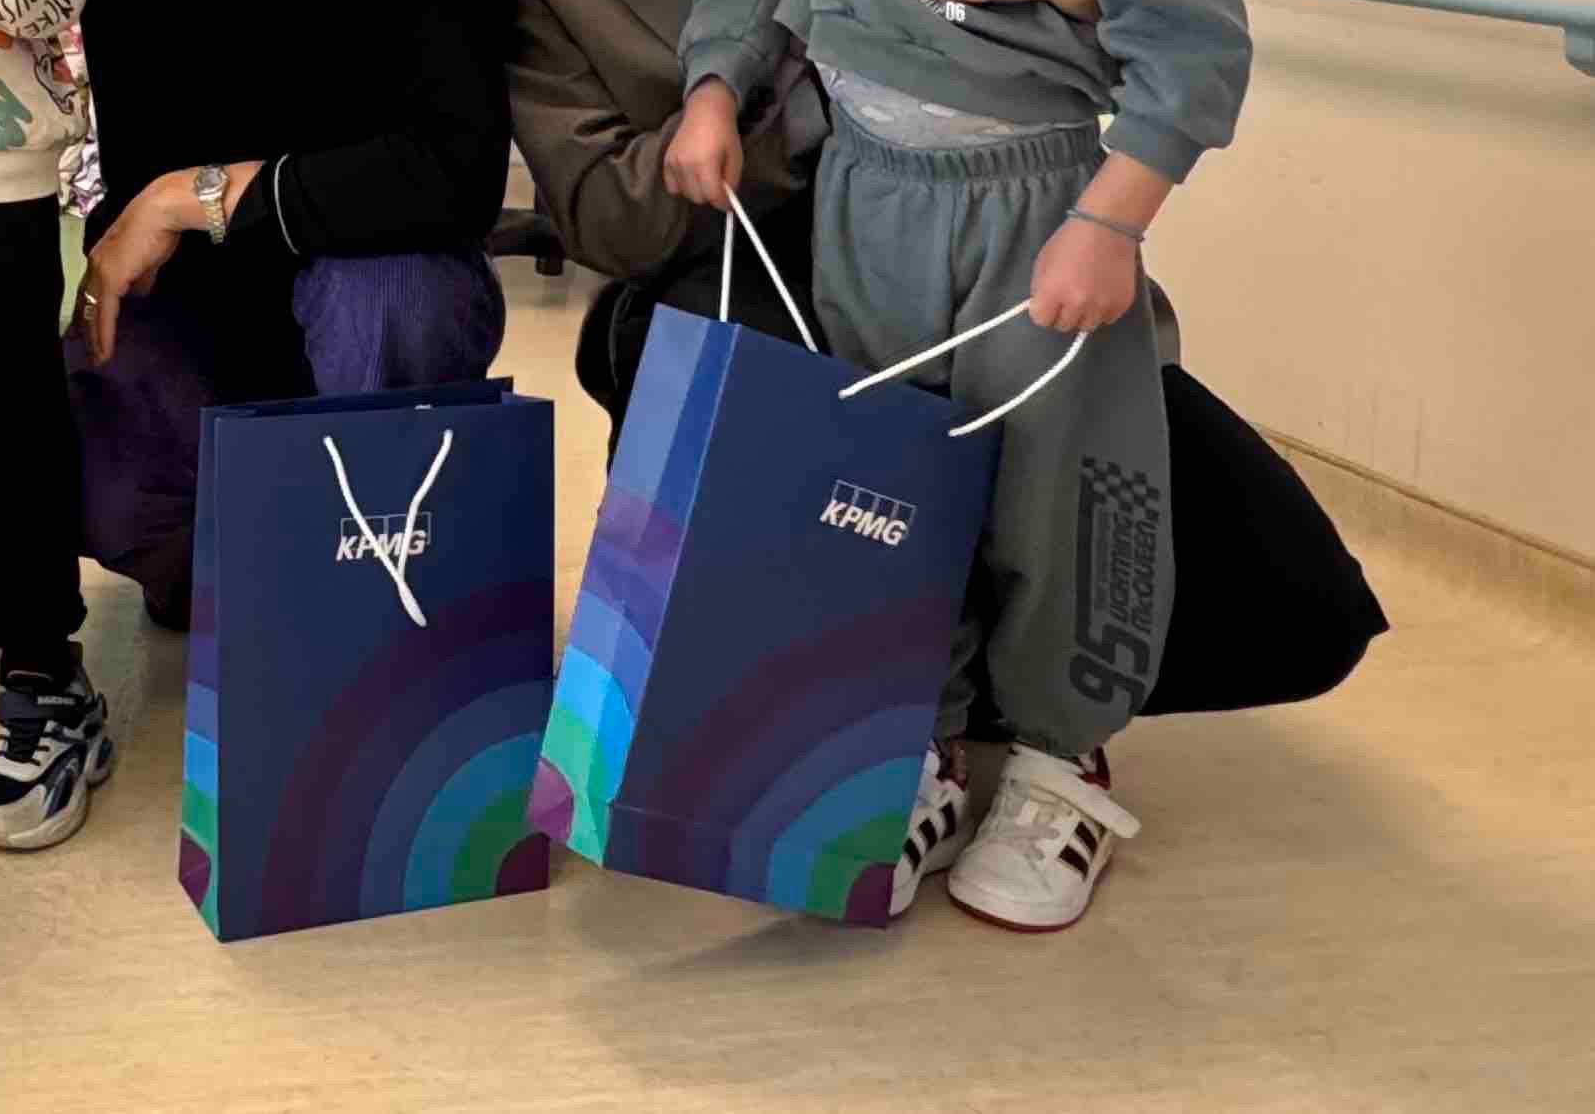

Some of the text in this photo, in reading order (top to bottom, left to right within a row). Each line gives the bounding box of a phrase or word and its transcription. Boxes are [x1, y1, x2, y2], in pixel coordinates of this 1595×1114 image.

[335, 529, 426, 561] KPMG
[819, 498, 908, 547] KPMG
[1068, 621, 1151, 717] 95
